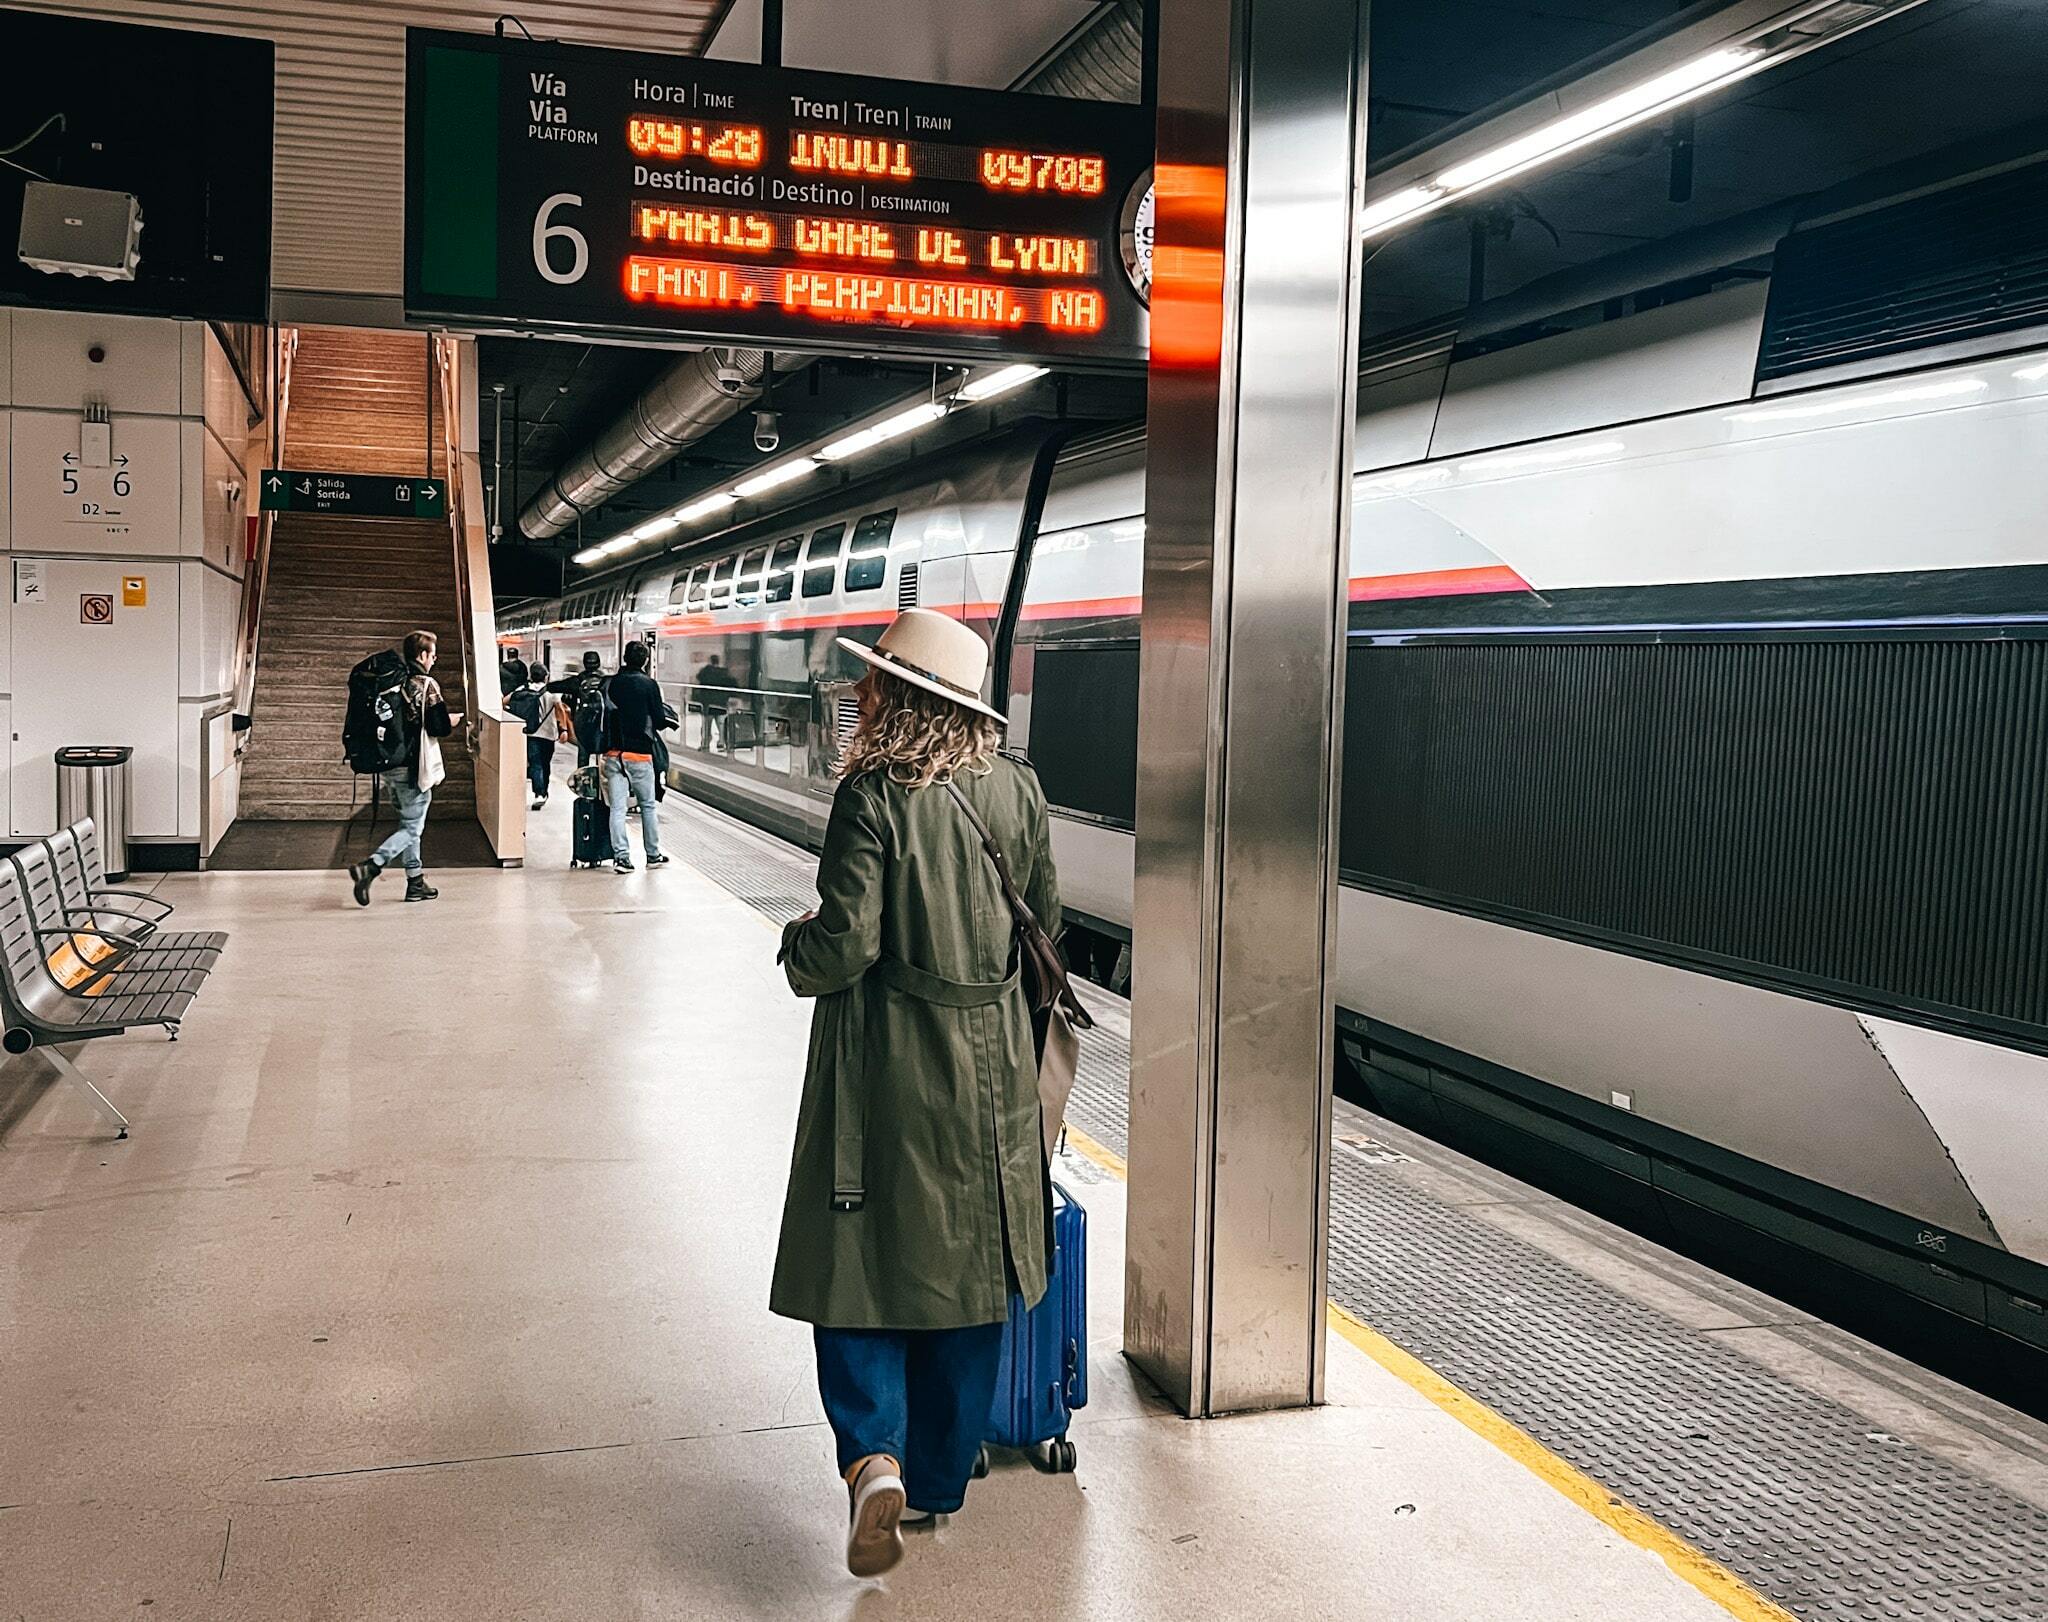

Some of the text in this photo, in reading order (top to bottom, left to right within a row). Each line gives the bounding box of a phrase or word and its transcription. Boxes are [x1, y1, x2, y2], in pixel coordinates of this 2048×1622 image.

[530, 72, 567, 97] Vía
[634, 78, 735, 109] Hora TIME
[529, 100, 568, 124] Via
[791, 96, 952, 131] Tren Tren TRAIN
[528, 124, 598, 145] PLATFORM
[634, 165, 950, 214] Destinació Destino DESTINATION
[532, 193, 589, 284] 6
[990, 235, 1086, 274] LYON
[1050, 290, 1097, 328] NA
[63, 469, 131, 497] 5 6
[317, 478, 345, 488] Salida
[317, 489, 351, 500] Sortida
